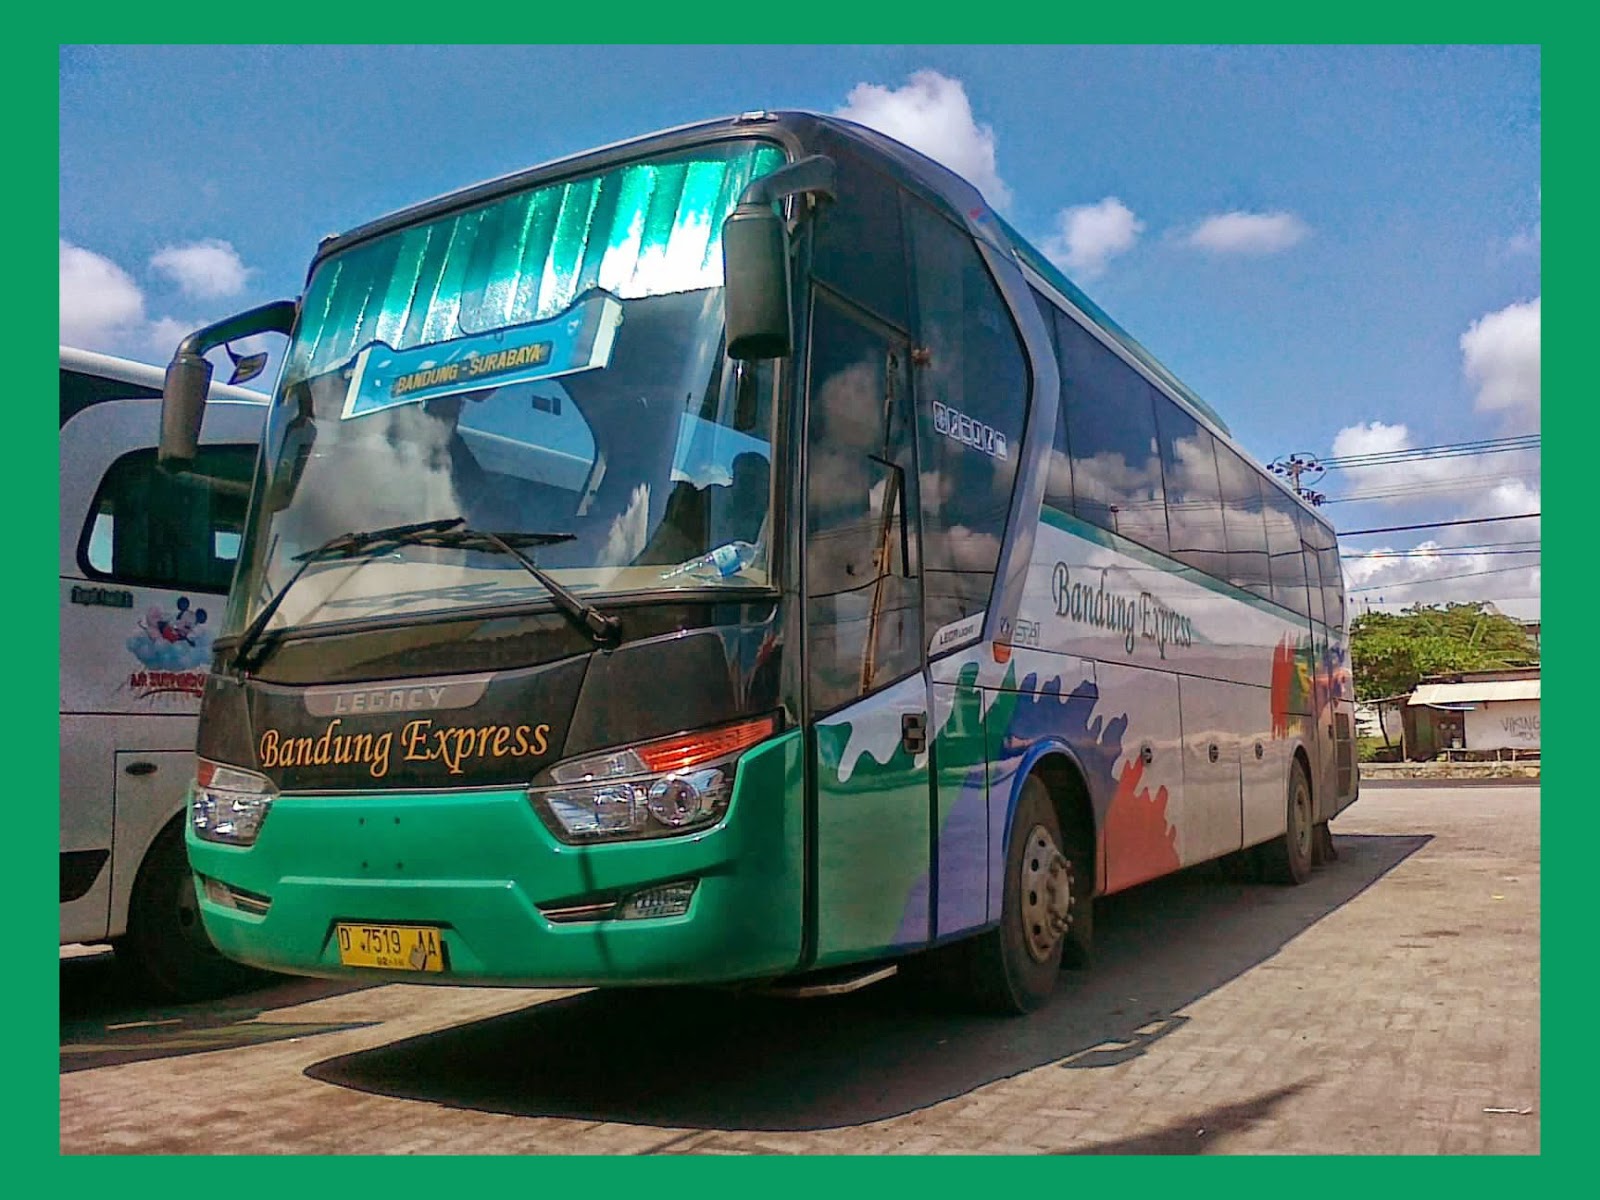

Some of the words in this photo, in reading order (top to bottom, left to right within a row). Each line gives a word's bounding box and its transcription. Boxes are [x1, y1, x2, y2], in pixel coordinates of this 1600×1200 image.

[396, 363, 459, 393] BANDUNG
[468, 343, 542, 376] SURABAYA
[1051, 560, 1136, 656] Bandung
[1139, 591, 1193, 661] Express
[333, 686, 447, 715] LEGACY
[259, 718, 394, 778] Bandung
[400, 718, 551, 775] Express
[340, 927, 352, 952] D
[362, 927, 401, 955] 7519
